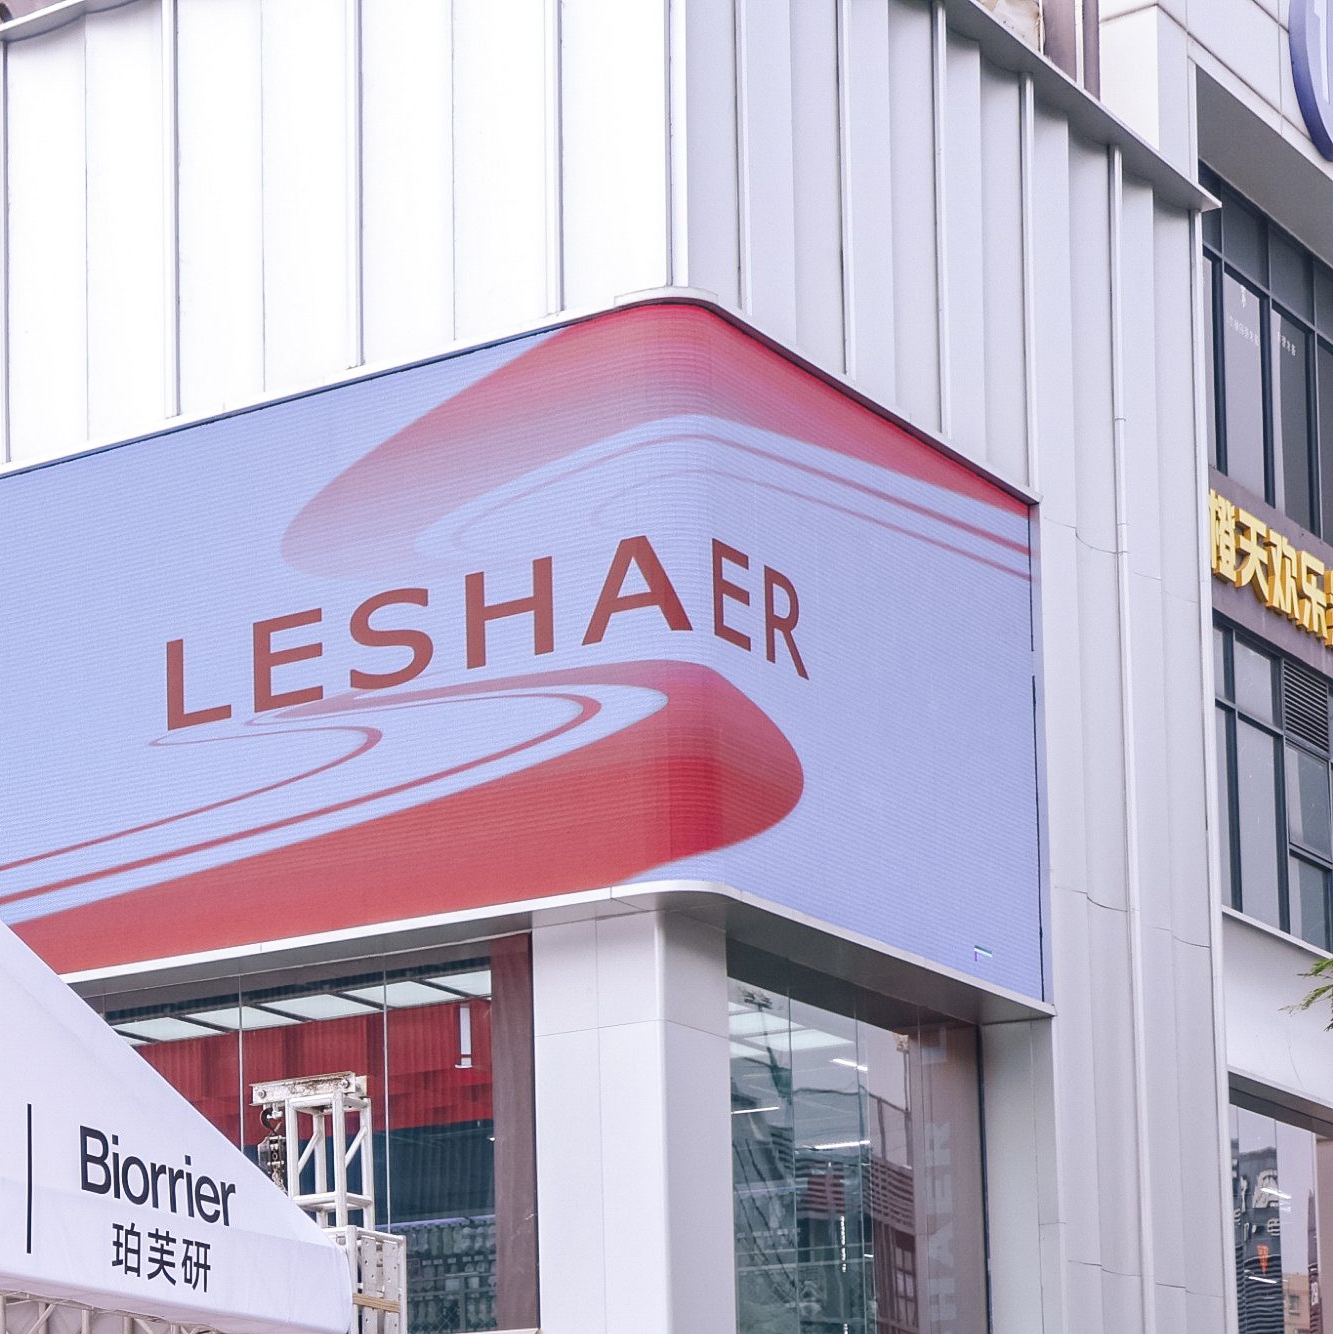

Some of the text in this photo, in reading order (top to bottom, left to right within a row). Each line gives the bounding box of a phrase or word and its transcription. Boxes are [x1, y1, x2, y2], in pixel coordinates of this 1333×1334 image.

[164, 535, 811, 732] LESHAER
[78, 1125, 236, 1226] Biorrier
[111, 1221, 211, 1292] 珀芙研
